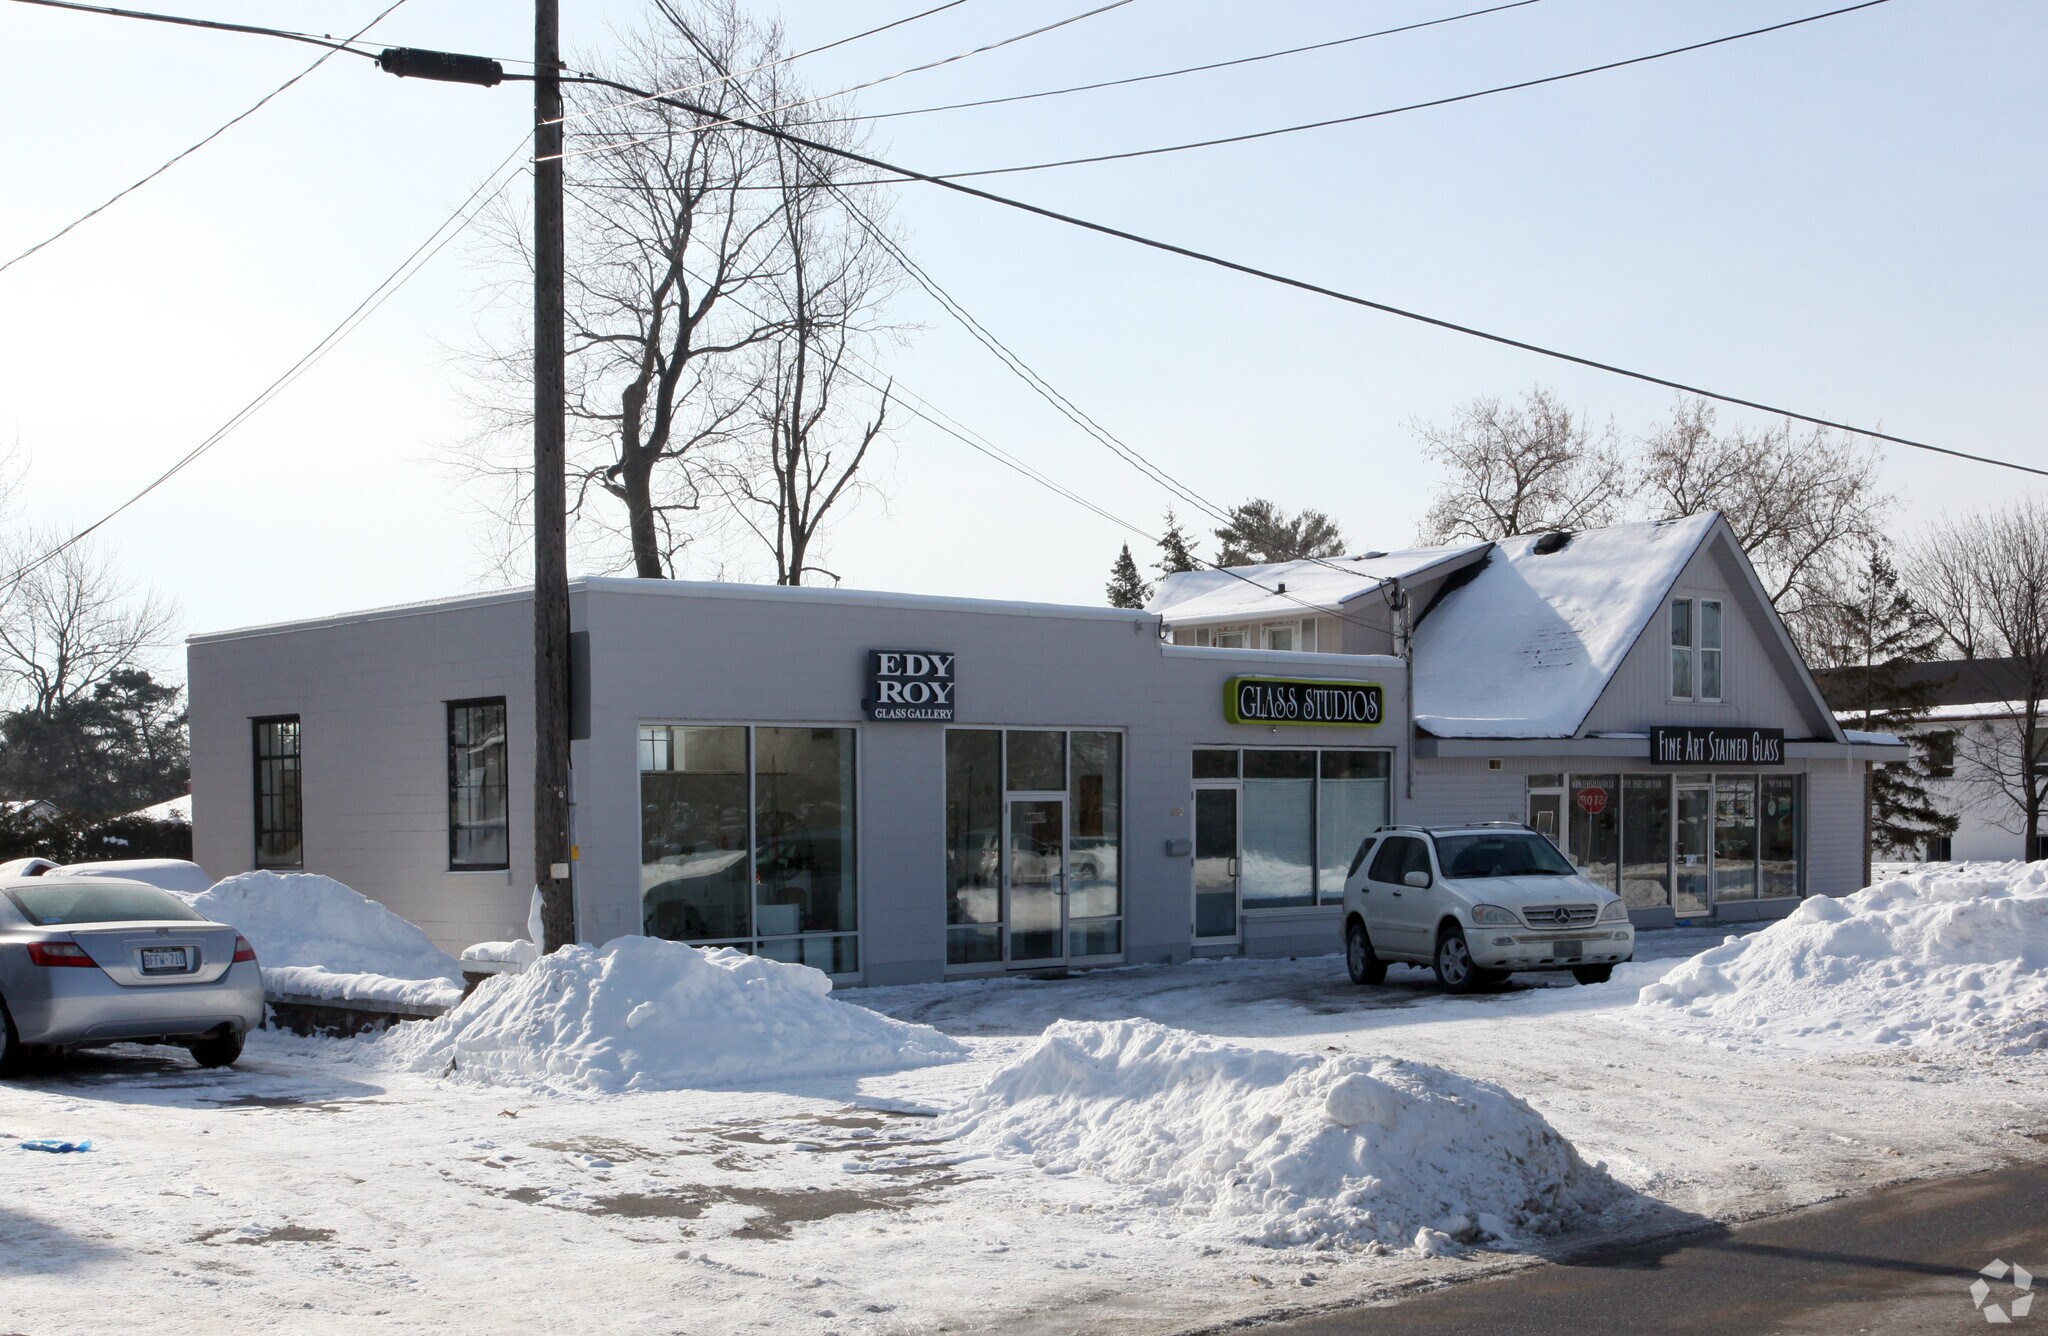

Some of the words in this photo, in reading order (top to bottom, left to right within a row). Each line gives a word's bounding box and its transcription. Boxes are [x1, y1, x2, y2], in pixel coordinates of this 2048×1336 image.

[877, 653, 955, 677] EDY
[877, 680, 955, 704] ROY
[1240, 686, 1298, 719] GLASS
[1303, 688, 1378, 721] STUDIOS
[875, 708, 906, 719] GLASS
[907, 709, 953, 719] GALLERY
[1659, 730, 1682, 761] FINE
[1685, 731, 1704, 761] ART
[1752, 731, 1779, 762] GLASS
